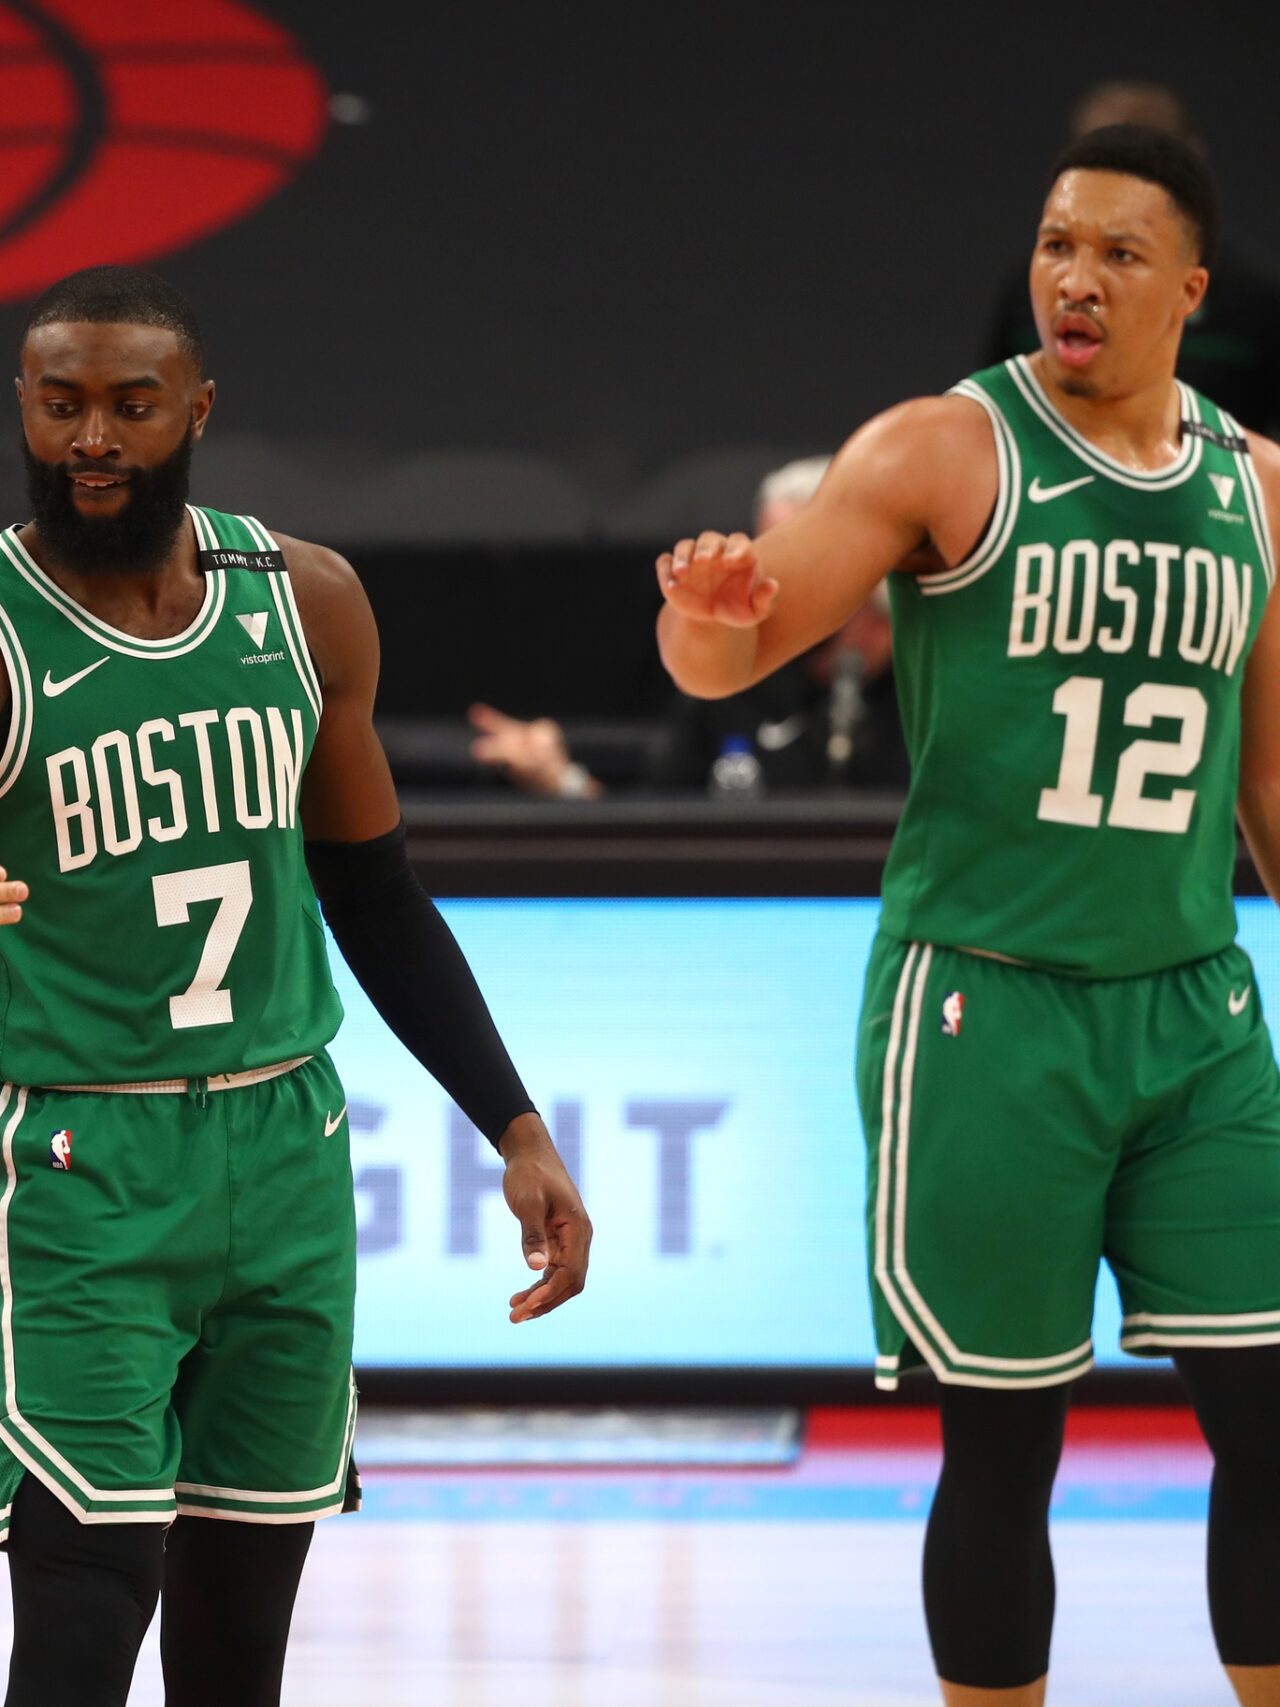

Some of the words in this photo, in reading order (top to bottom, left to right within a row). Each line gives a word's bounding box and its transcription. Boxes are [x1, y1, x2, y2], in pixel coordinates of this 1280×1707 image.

[211, 553, 248, 567] TOMMY
[1008, 540, 1252, 676] BOSTON
[240, 650, 285, 665] vistaprint
[46, 706, 304, 873] BOSTON
[1037, 675, 1208, 833] 12
[151, 860, 253, 1029] 7
[346, 1097, 733, 1256] GHT
